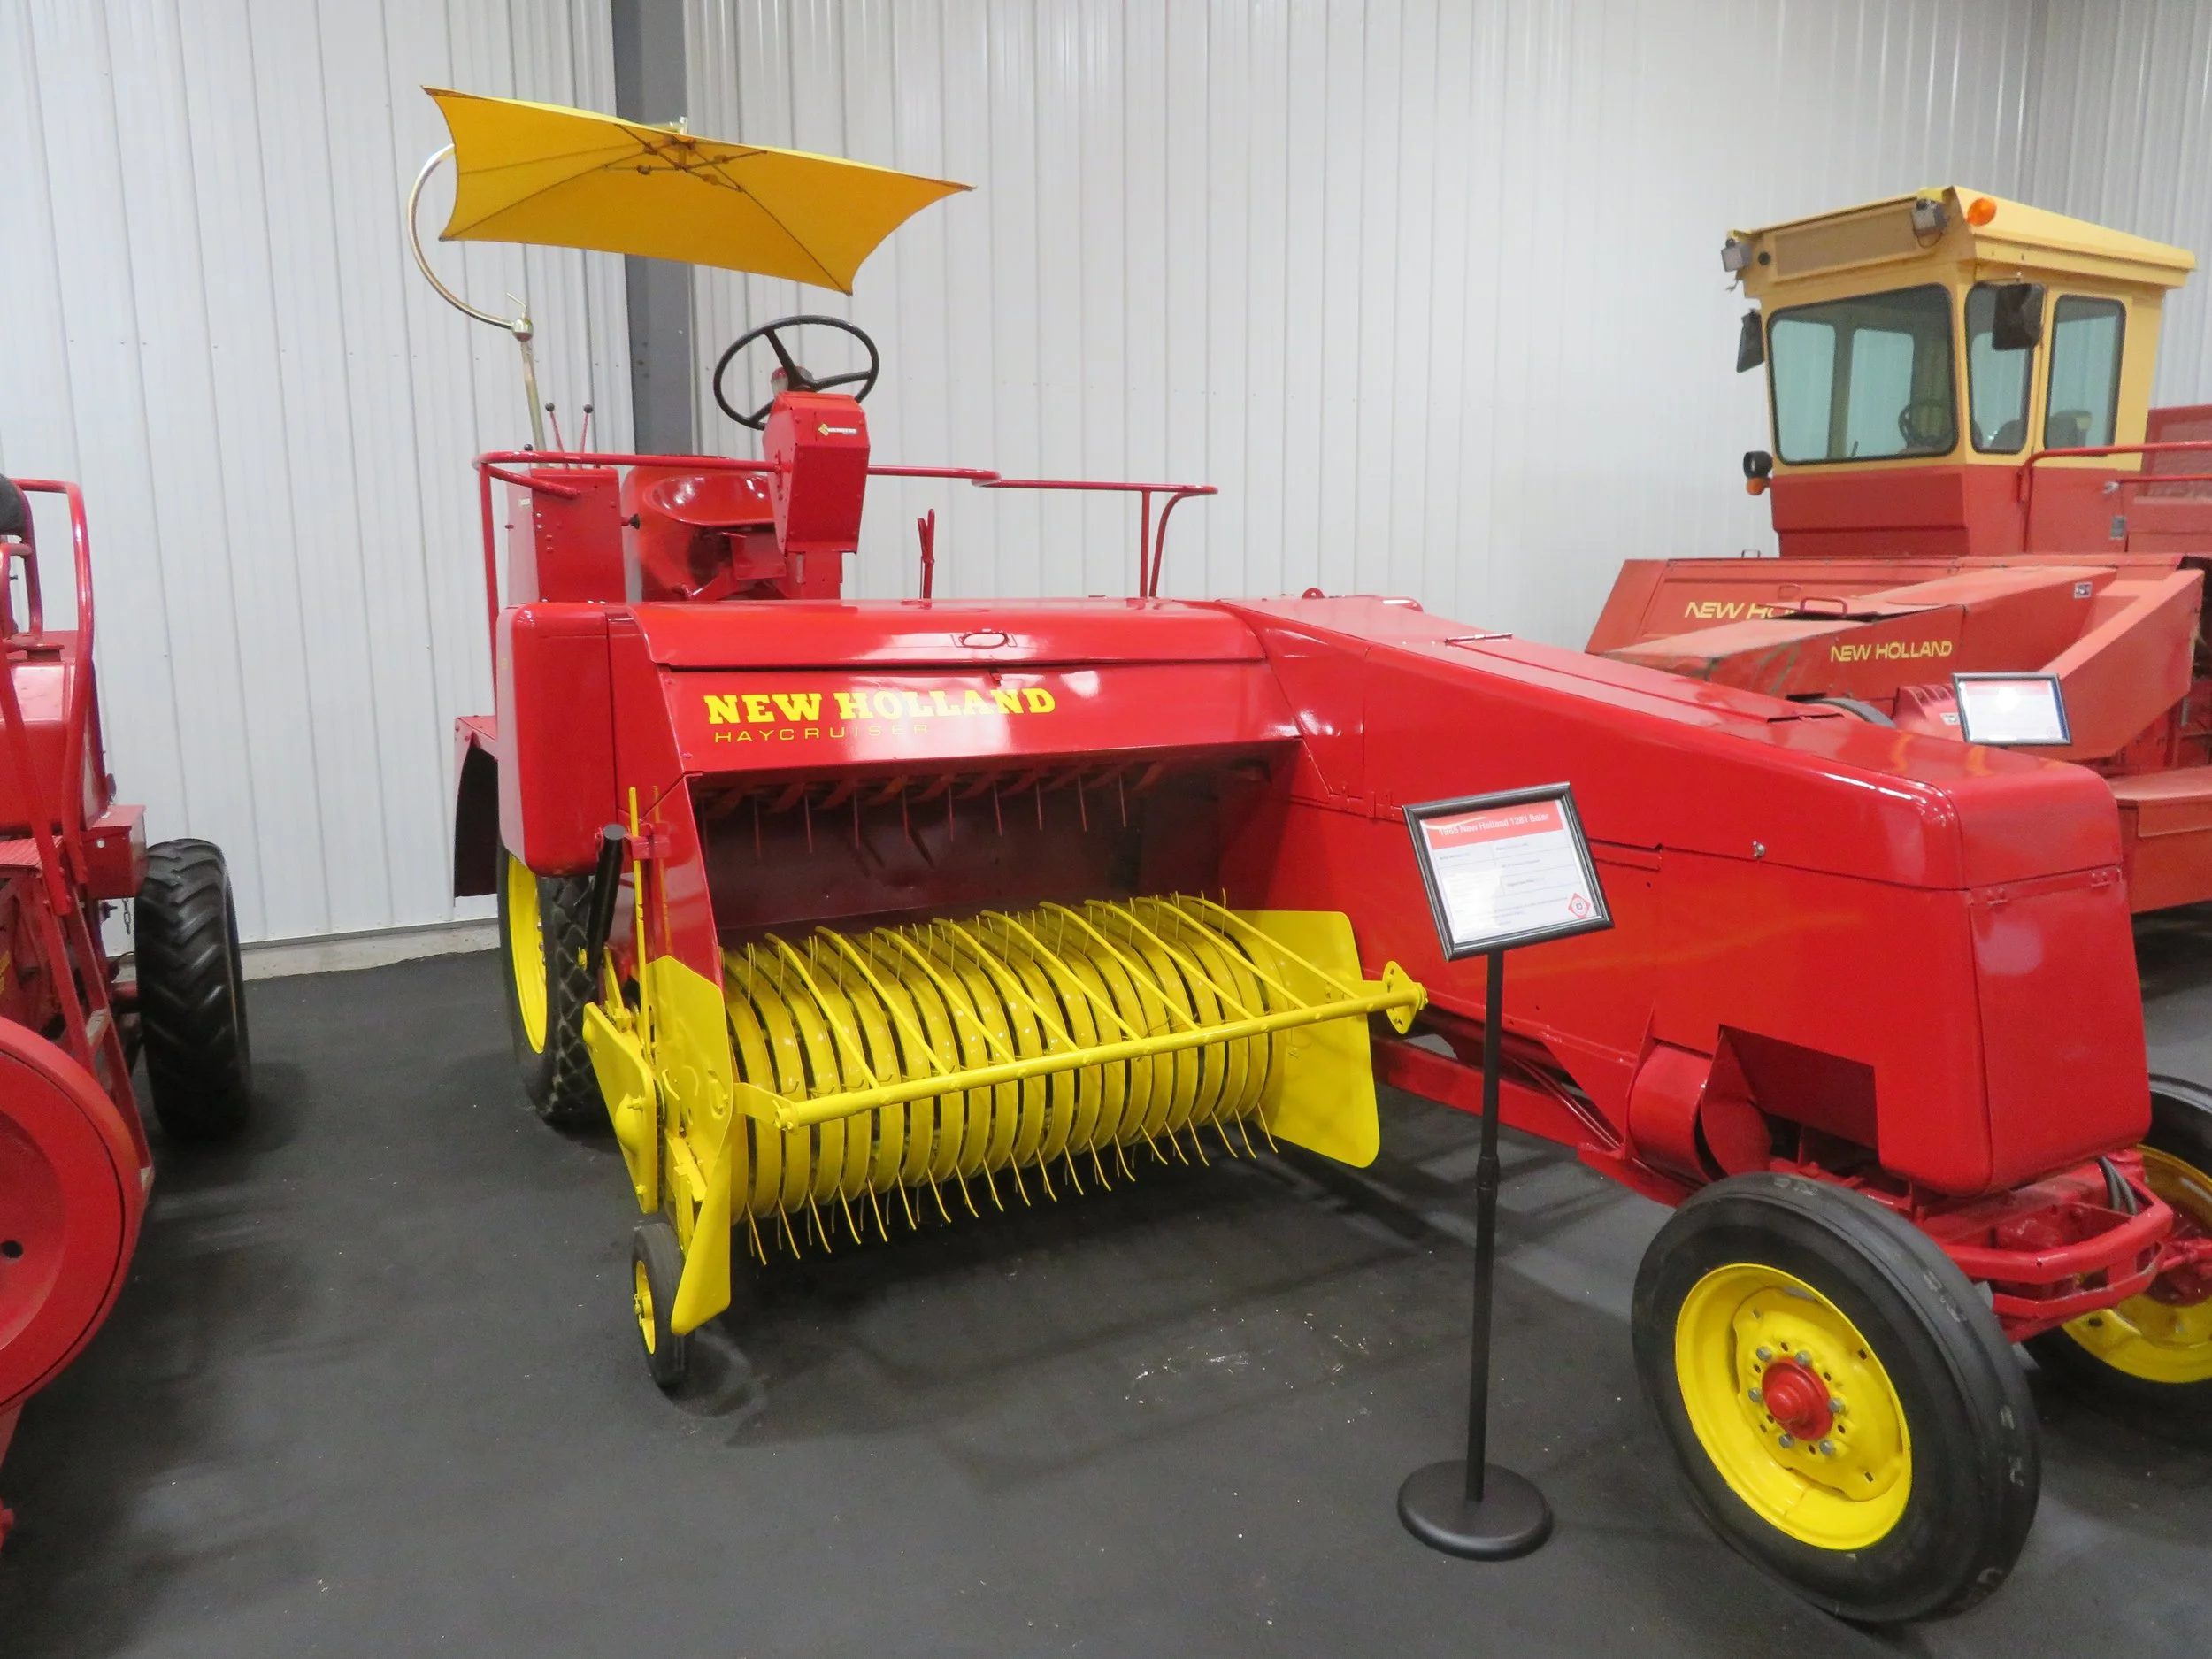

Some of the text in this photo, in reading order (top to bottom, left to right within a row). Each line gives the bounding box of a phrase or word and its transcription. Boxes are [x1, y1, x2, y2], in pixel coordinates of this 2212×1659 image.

[1685, 601, 1745, 619] NEW
[1831, 641, 1952, 662] NEW HOLLAND
[703, 687, 1056, 724] NEW HOLLAND
[715, 724, 928, 743] HAYCRUISER
[1460, 824, 1478, 833] New
[1479, 819, 1509, 831] Holland
